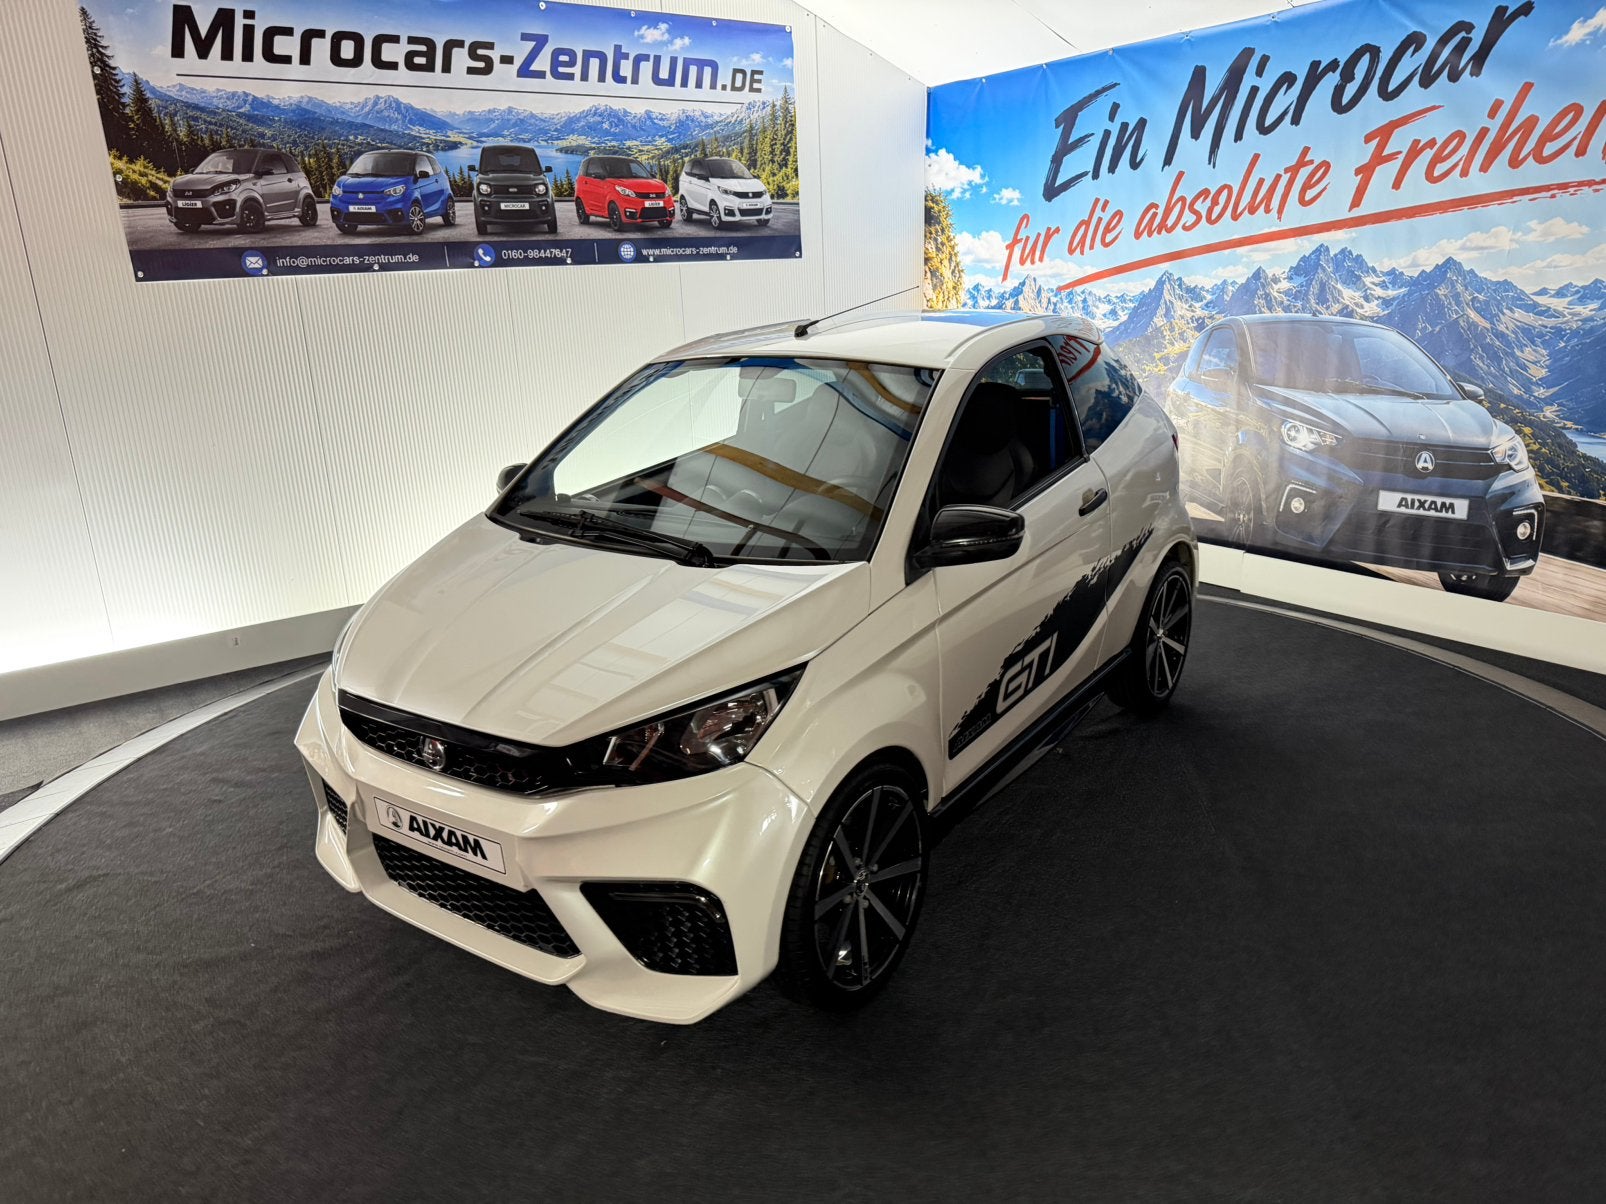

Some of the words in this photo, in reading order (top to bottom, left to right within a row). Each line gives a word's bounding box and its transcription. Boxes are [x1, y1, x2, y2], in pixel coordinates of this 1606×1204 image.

[171, 4, 764, 94] Microcars-Zentrum.DE
[1043, 82, 1147, 202] Ein
[1162, 1, 1535, 170] Microcar
[1002, 215, 1060, 283] fur
[1068, 199, 1123, 256] die
[1134, 146, 1331, 240] absolute
[276, 253, 419, 267] info@microcars-zentrum.de
[502, 248, 572, 259] 0160-98447647
[642, 245, 738, 256] www.microcars-zentrum.de
[1396, 497, 1455, 515] AIXAM
[996, 631, 1058, 714] GTI
[408, 814, 488, 861] AIXAM
